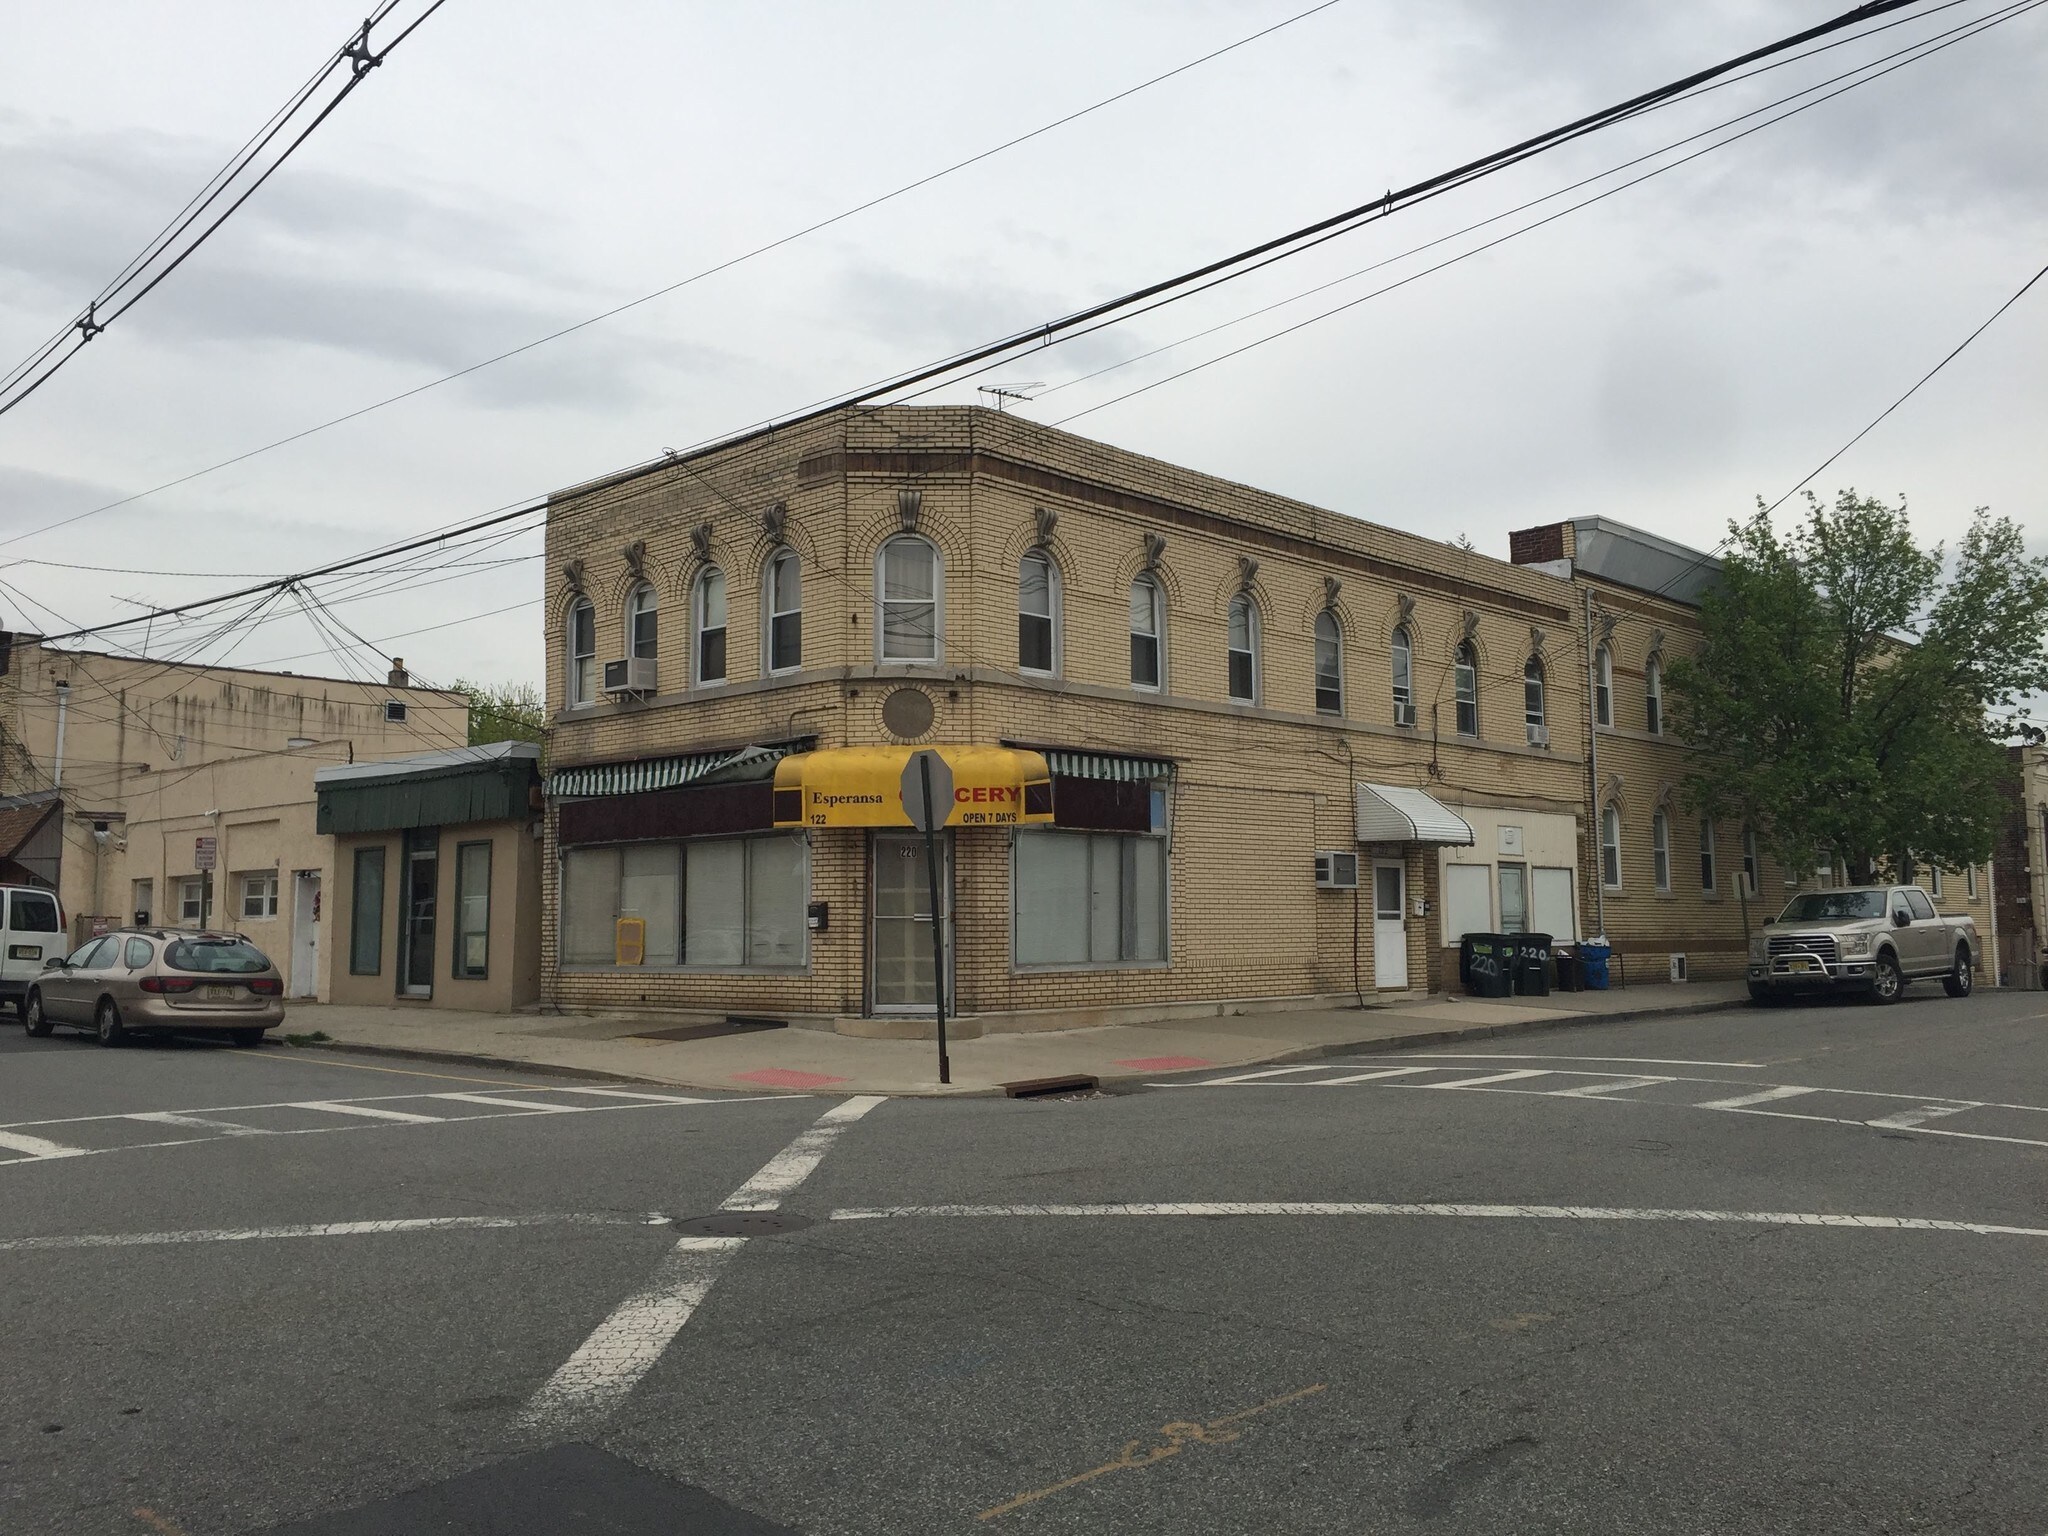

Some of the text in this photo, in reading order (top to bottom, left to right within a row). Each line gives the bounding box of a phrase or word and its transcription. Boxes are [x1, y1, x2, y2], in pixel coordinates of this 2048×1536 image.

[813, 792, 883, 807] Esperansa
[810, 814, 826, 825] 122
[963, 812, 1017, 823] OPEN 7 DAYS
[901, 846, 917, 858] 220
[1520, 946, 1547, 961] 220
[1470, 954, 1496, 976] 220
